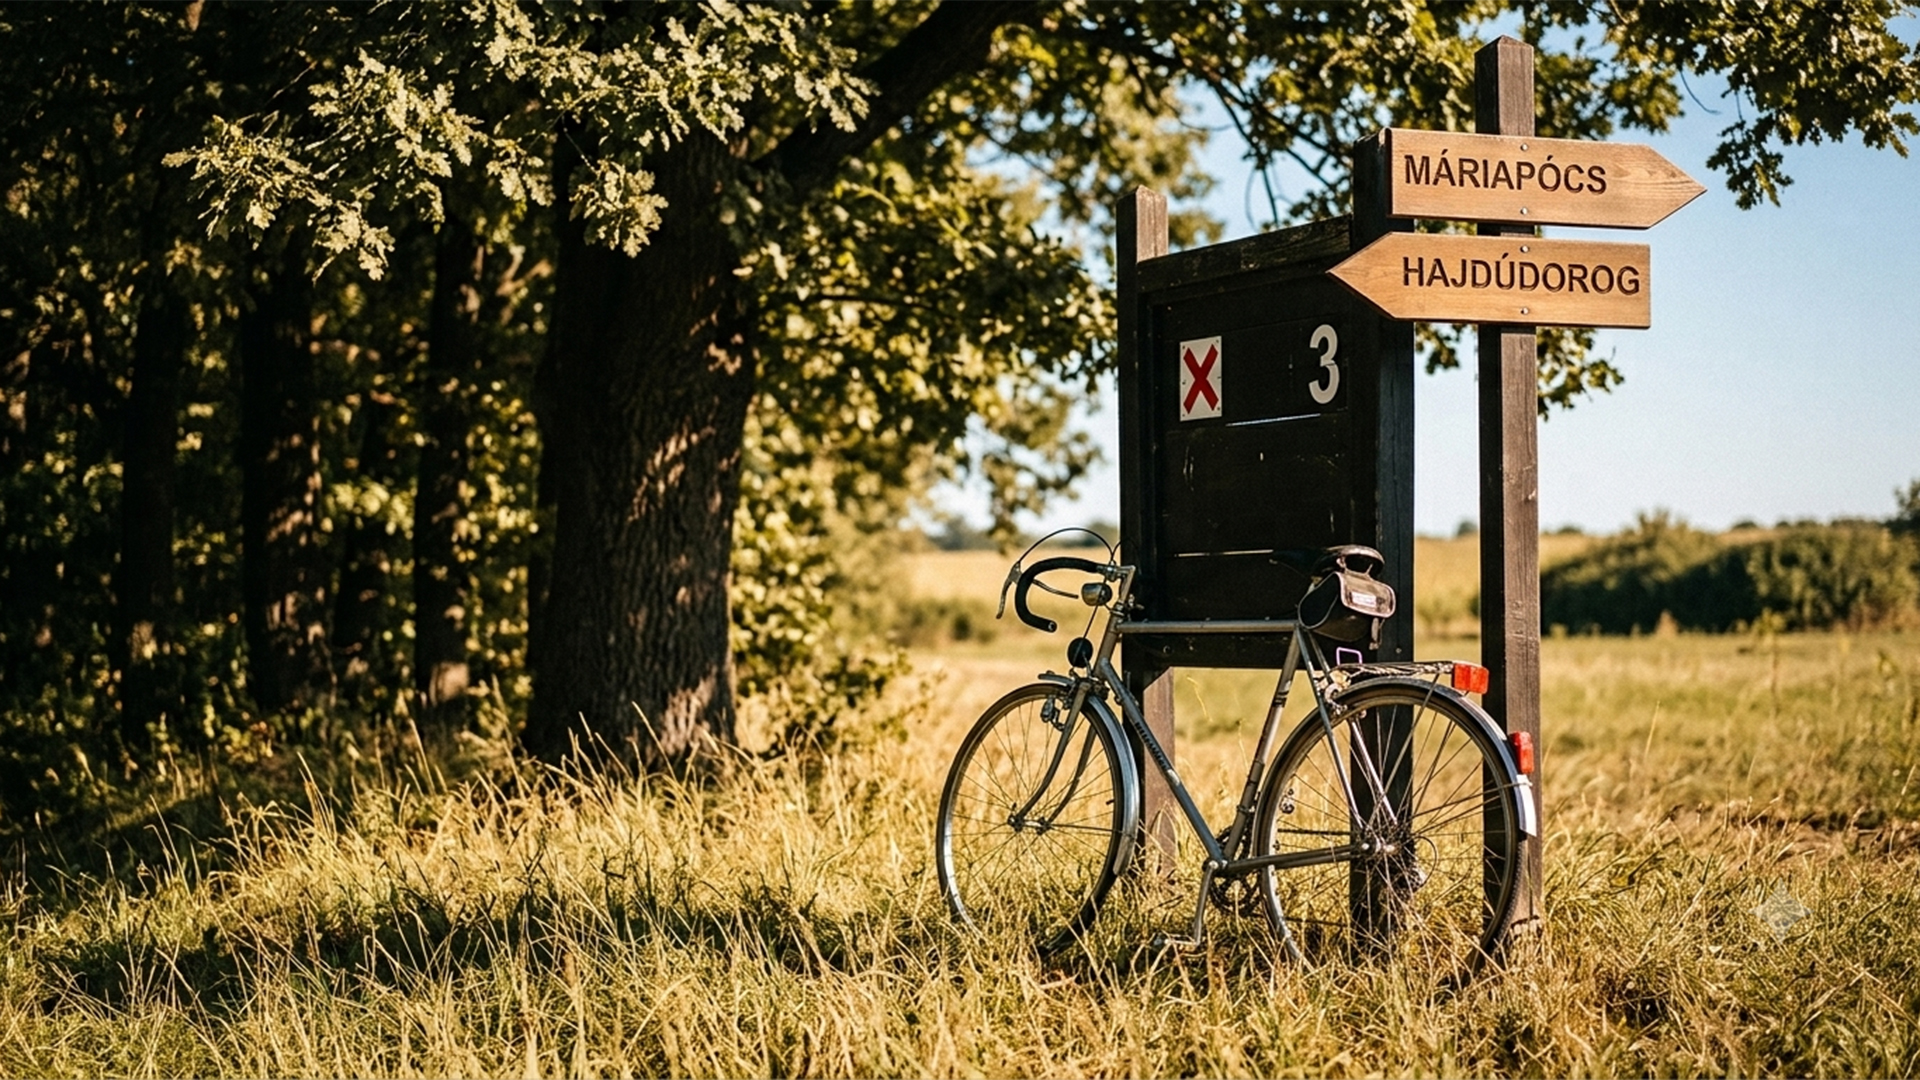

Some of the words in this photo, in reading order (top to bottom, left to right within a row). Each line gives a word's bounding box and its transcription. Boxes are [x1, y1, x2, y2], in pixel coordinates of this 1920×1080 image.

[1404, 149, 1607, 195] MÁRIAPÓCS
[1402, 252, 1640, 296] HAJDÚDOROG
[1308, 324, 1340, 405] 3
